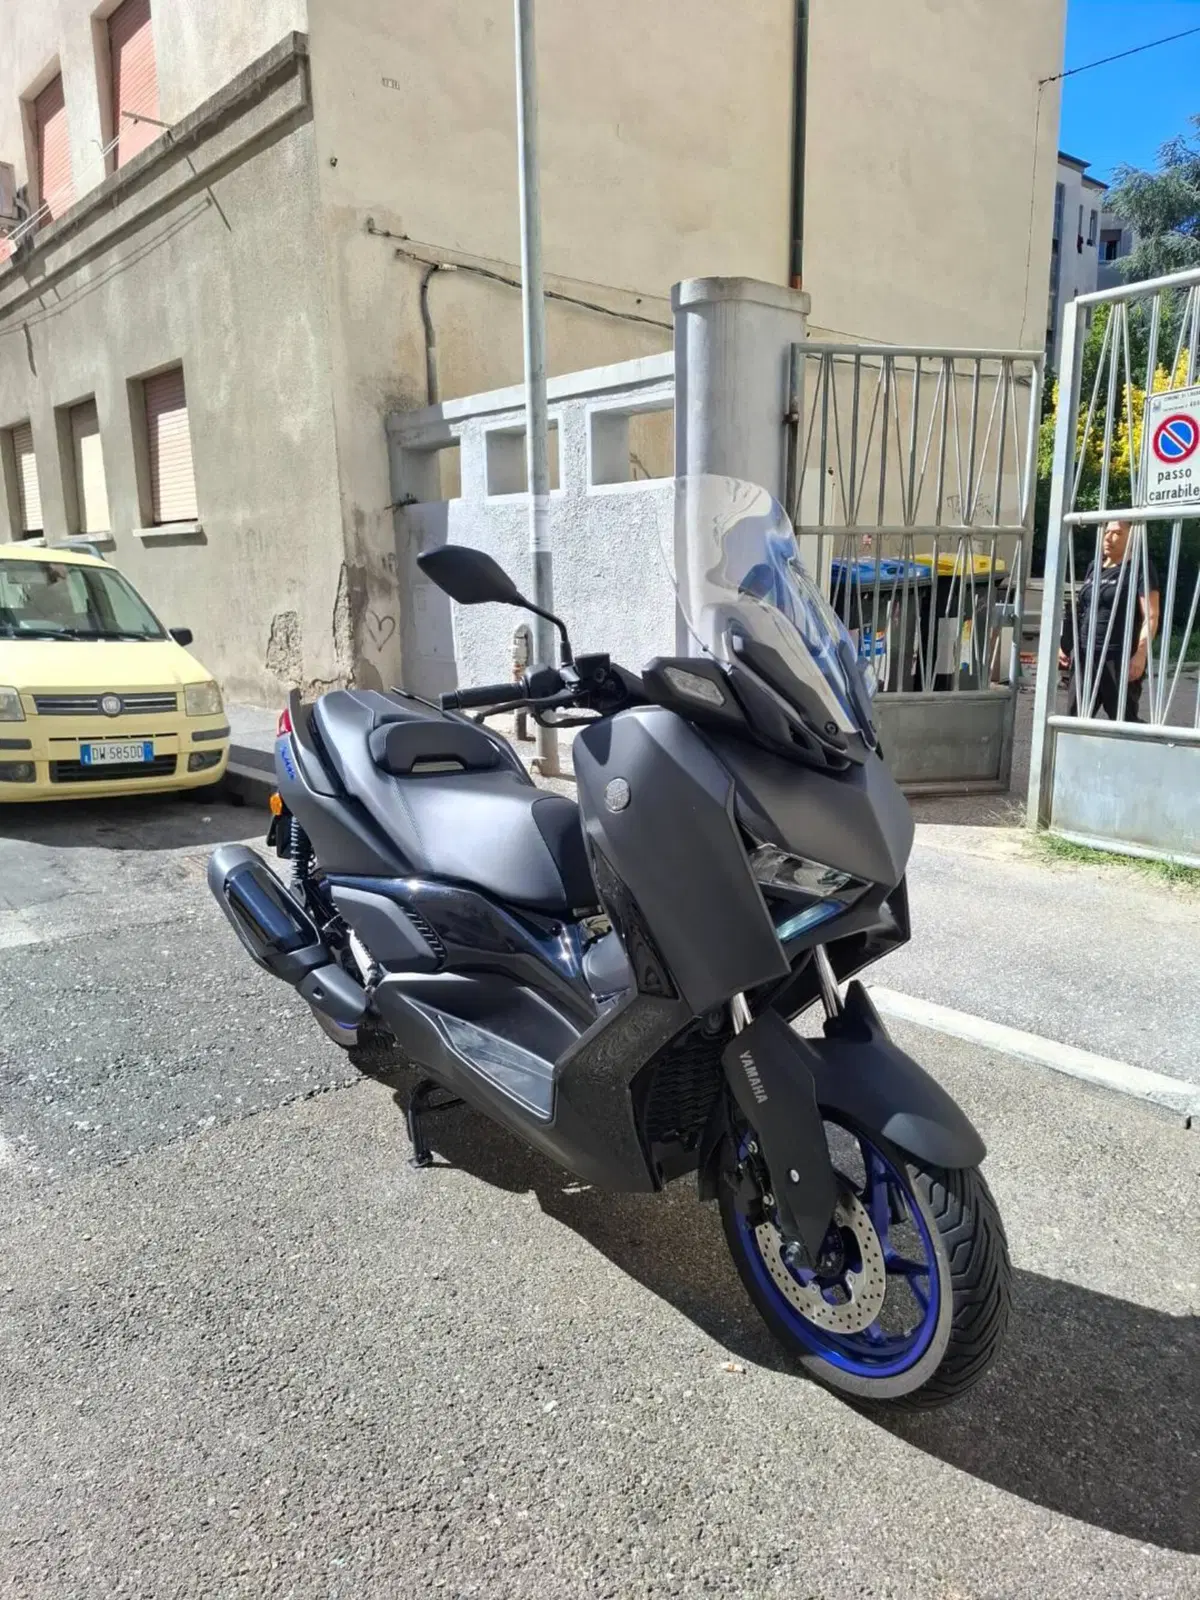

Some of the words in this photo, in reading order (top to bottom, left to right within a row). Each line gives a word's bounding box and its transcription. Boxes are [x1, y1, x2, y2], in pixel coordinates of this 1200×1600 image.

[1157, 468, 1192, 485] passo
[1149, 483, 1200, 501] carrabile
[92, 747, 106, 761] DW
[739, 1050, 769, 1104] YAMAHA
